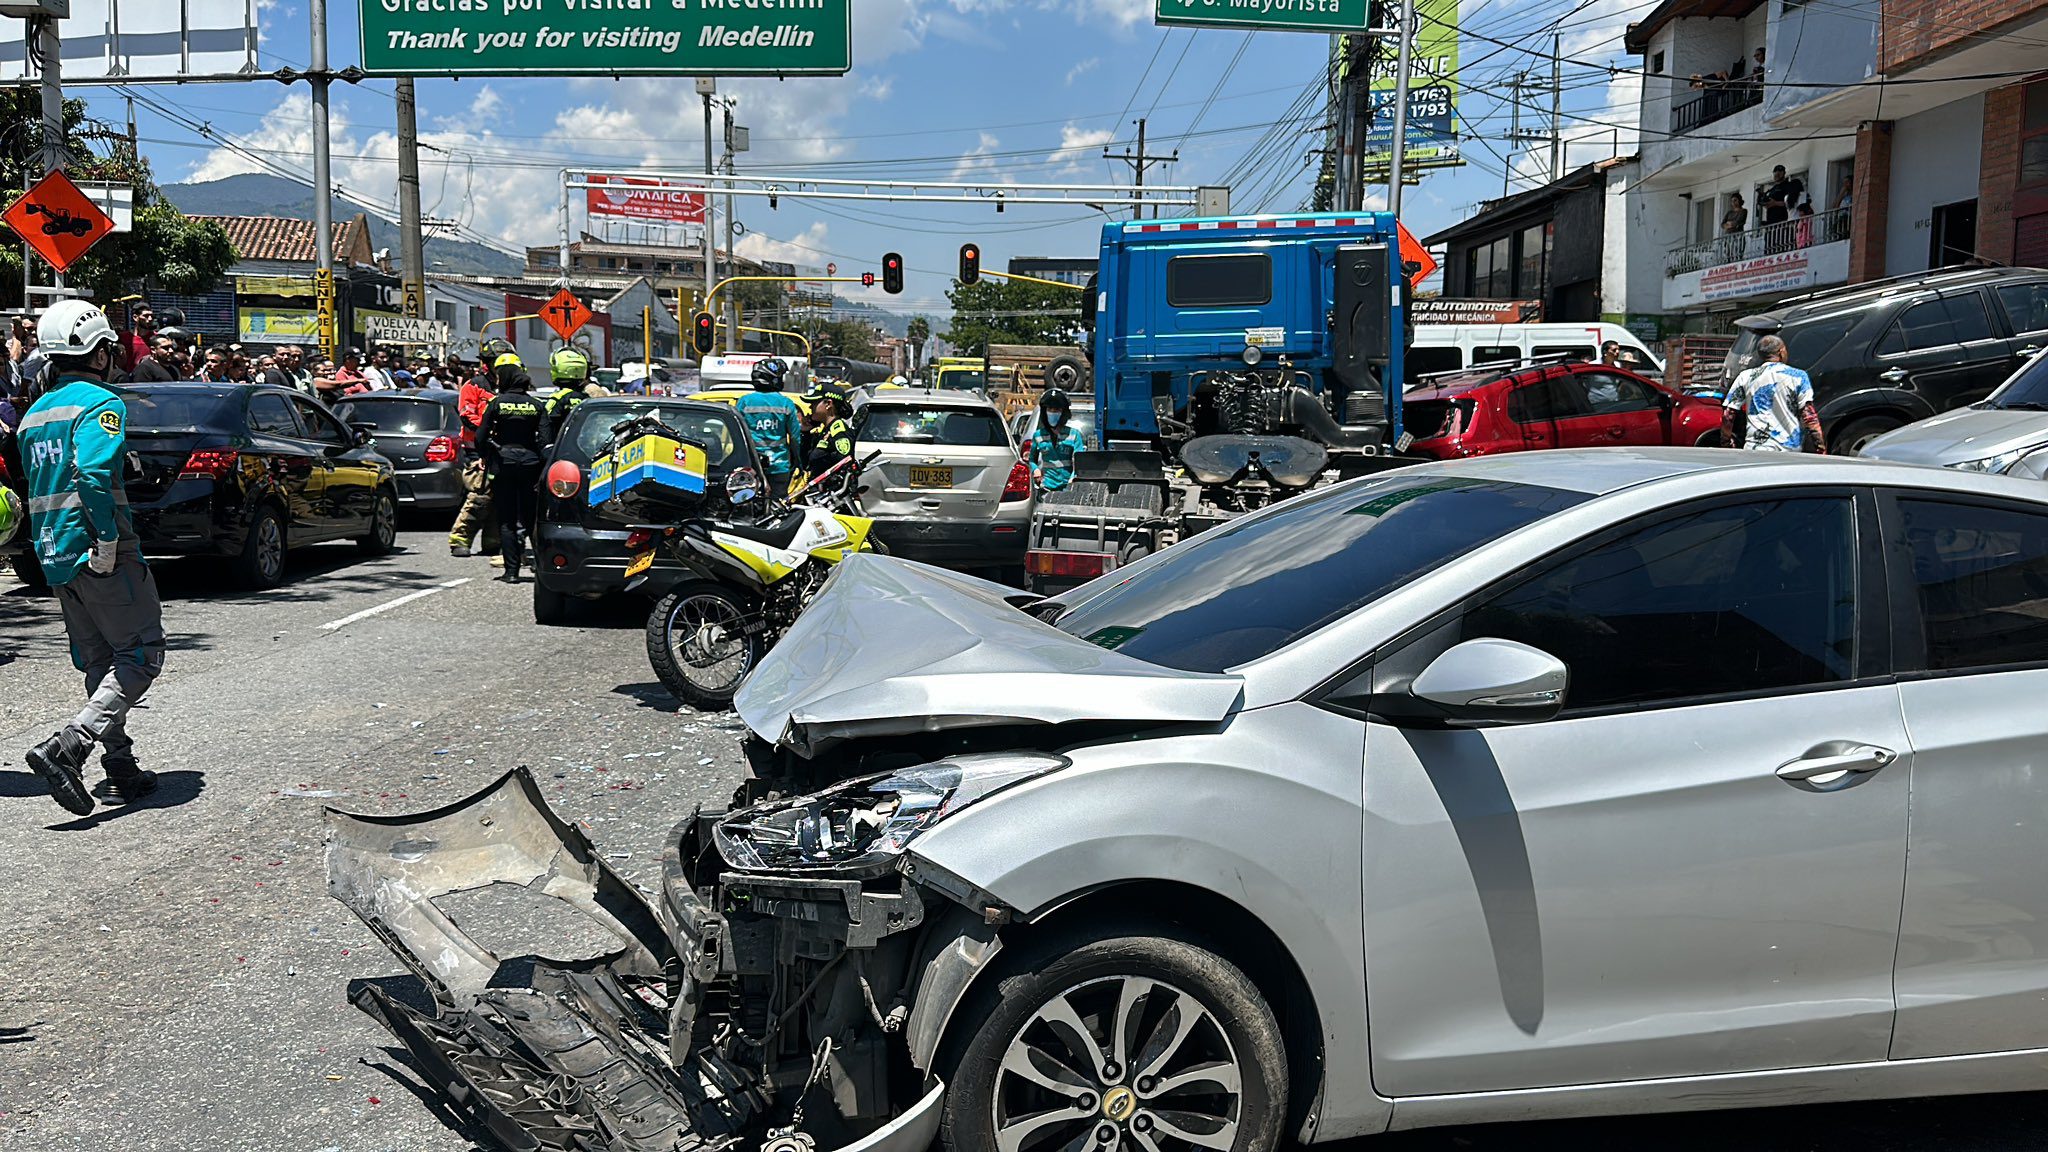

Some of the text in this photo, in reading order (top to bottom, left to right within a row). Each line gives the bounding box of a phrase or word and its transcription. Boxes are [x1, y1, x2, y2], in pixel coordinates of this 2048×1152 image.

[387, 25, 815, 54] Thank you for visiting Medellín
[1410, 103, 1447, 118] 1793
[1429, 302, 1513, 312] AUTOMOTRIZ
[1455, 311, 1495, 321] MECÁNICA
[373, 317, 437, 331] VUELVA A
[373, 329, 436, 341] MEDELLIN
[499, 402, 536, 411] POLICÍA
[756, 419, 779, 431] APH
